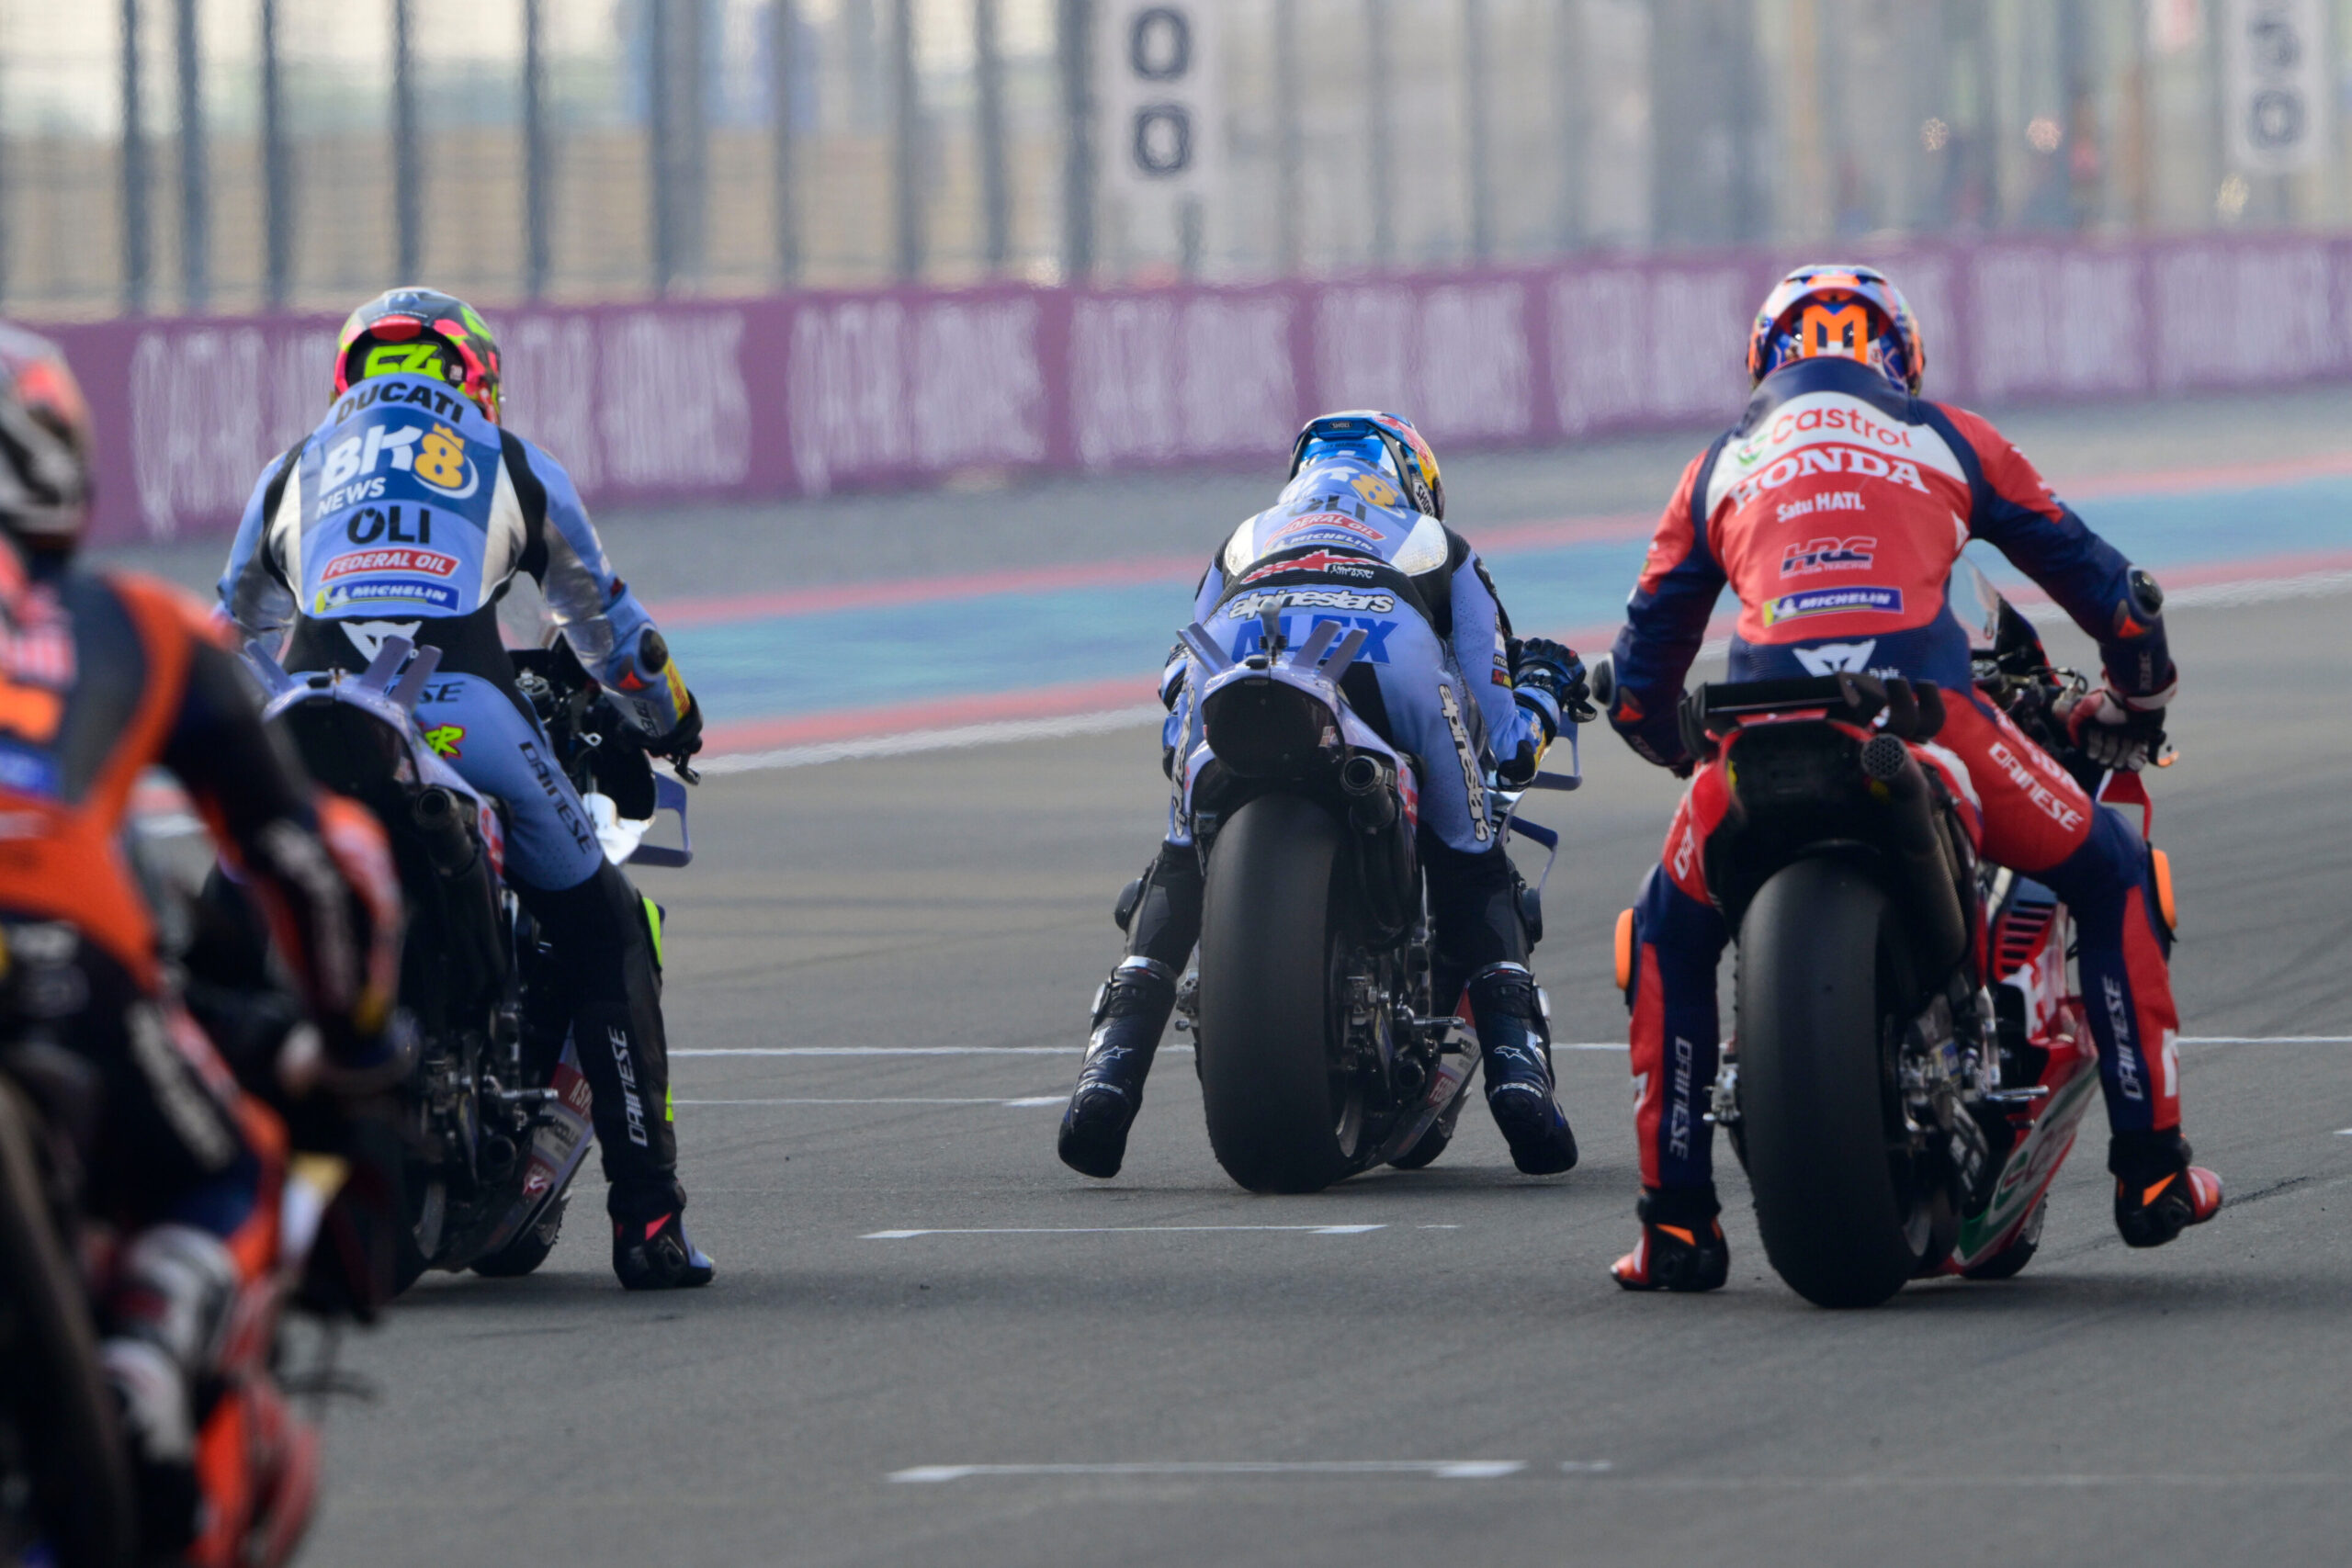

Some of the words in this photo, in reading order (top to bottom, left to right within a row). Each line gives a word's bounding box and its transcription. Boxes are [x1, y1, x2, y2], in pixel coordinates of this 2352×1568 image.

[364, 344, 447, 381] 54
[335, 381, 464, 425] DUCATI
[1772, 408, 1912, 448] Castrol
[319, 423, 465, 497] BK8
[315, 476, 387, 521] NEWS
[1729, 447, 1930, 516] HONDA
[347, 505, 430, 545] OLI
[1271, 514, 1344, 540] DERAL
[1348, 522, 1375, 537] OIL
[1776, 498, 1814, 523] Satu
[1291, 532, 1374, 551] MICHELIN
[1781, 536, 1877, 572] HRC
[327, 552, 411, 577] FEDERAL
[415, 554, 447, 572] OIL
[352, 584, 448, 601] MICHELIN
[1228, 590, 1396, 620] alpinestars
[1799, 592, 1891, 609] MICHELIN
[1231, 615, 1399, 665] ALEX
[519, 740, 602, 855] DAINESE
[1988, 741, 2086, 832] DAINESE
[2101, 974, 2144, 1101] DAINESE
[607, 1025, 649, 1148] DAINESE
[1668, 1035, 1693, 1162] DAINESE
